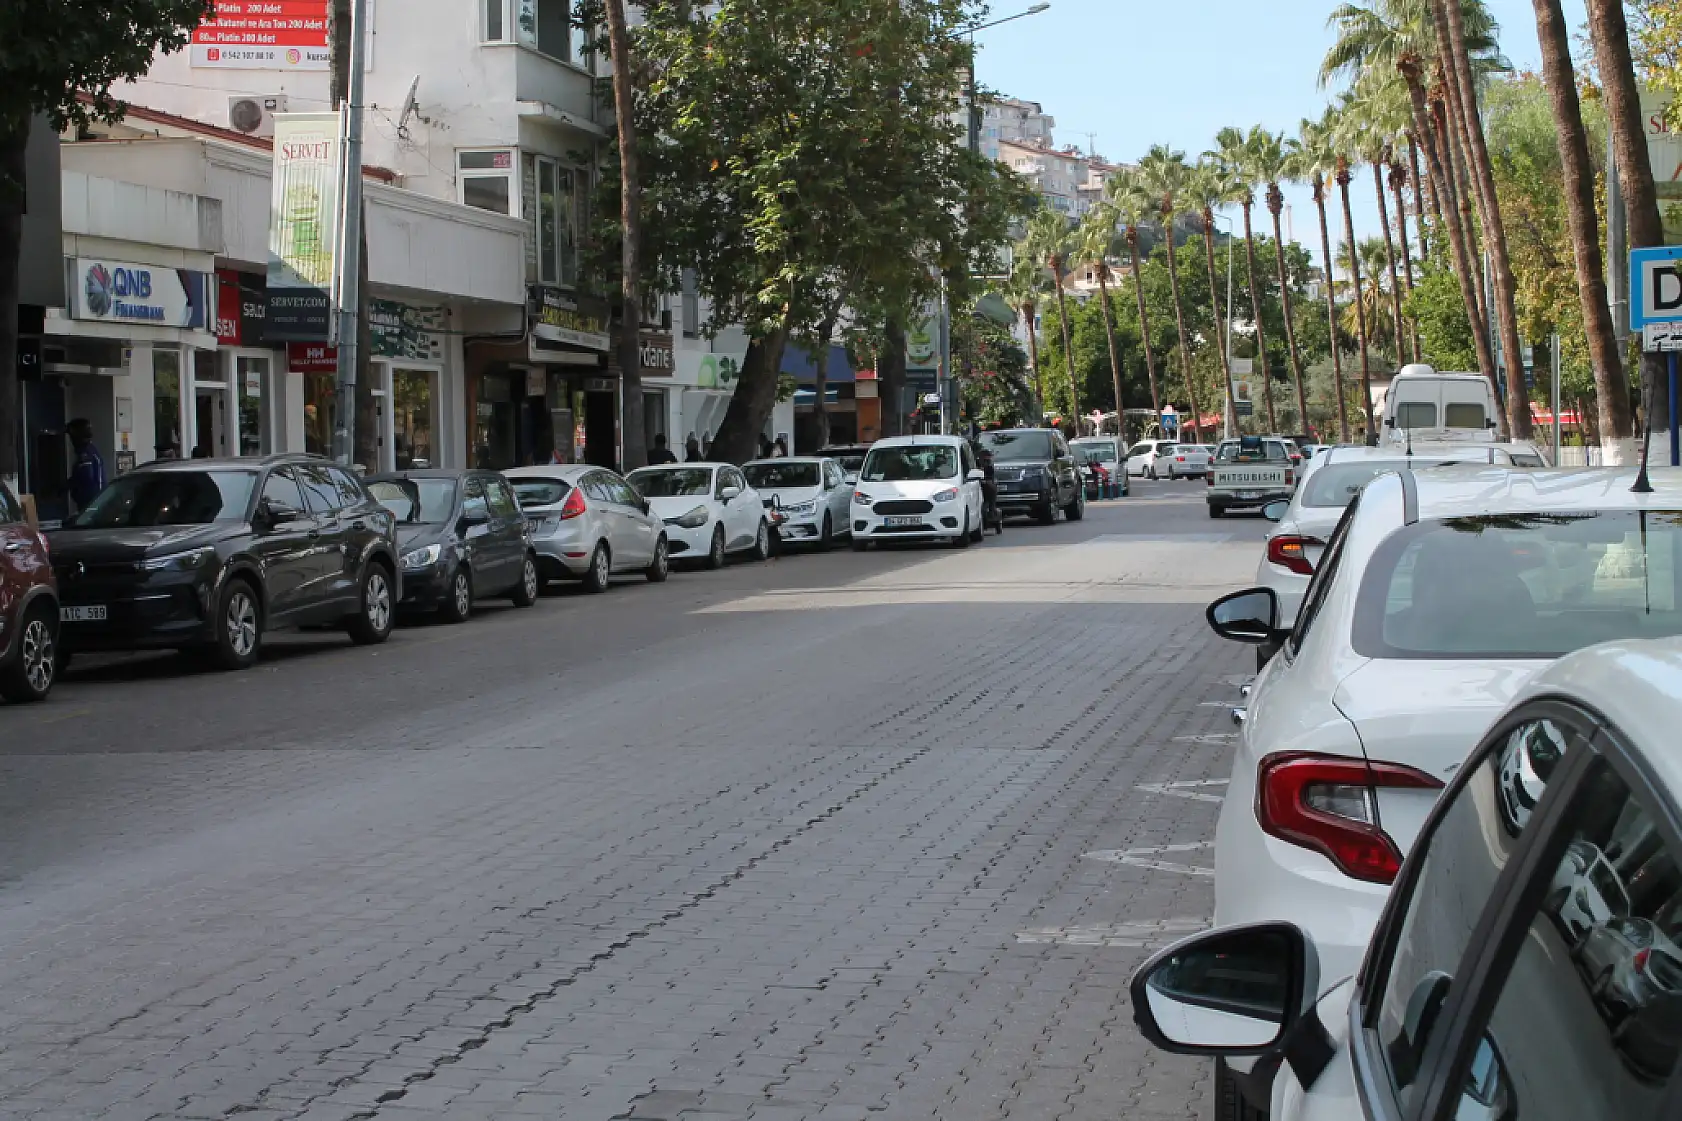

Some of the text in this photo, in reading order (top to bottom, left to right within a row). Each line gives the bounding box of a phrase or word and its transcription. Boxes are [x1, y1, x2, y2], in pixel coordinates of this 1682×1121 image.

[281, 142, 331, 160] SERVET
[115, 268, 152, 297] QNB
[1653, 267, 1682, 311] D
[1219, 472, 1281, 483] MITSUBISHI
